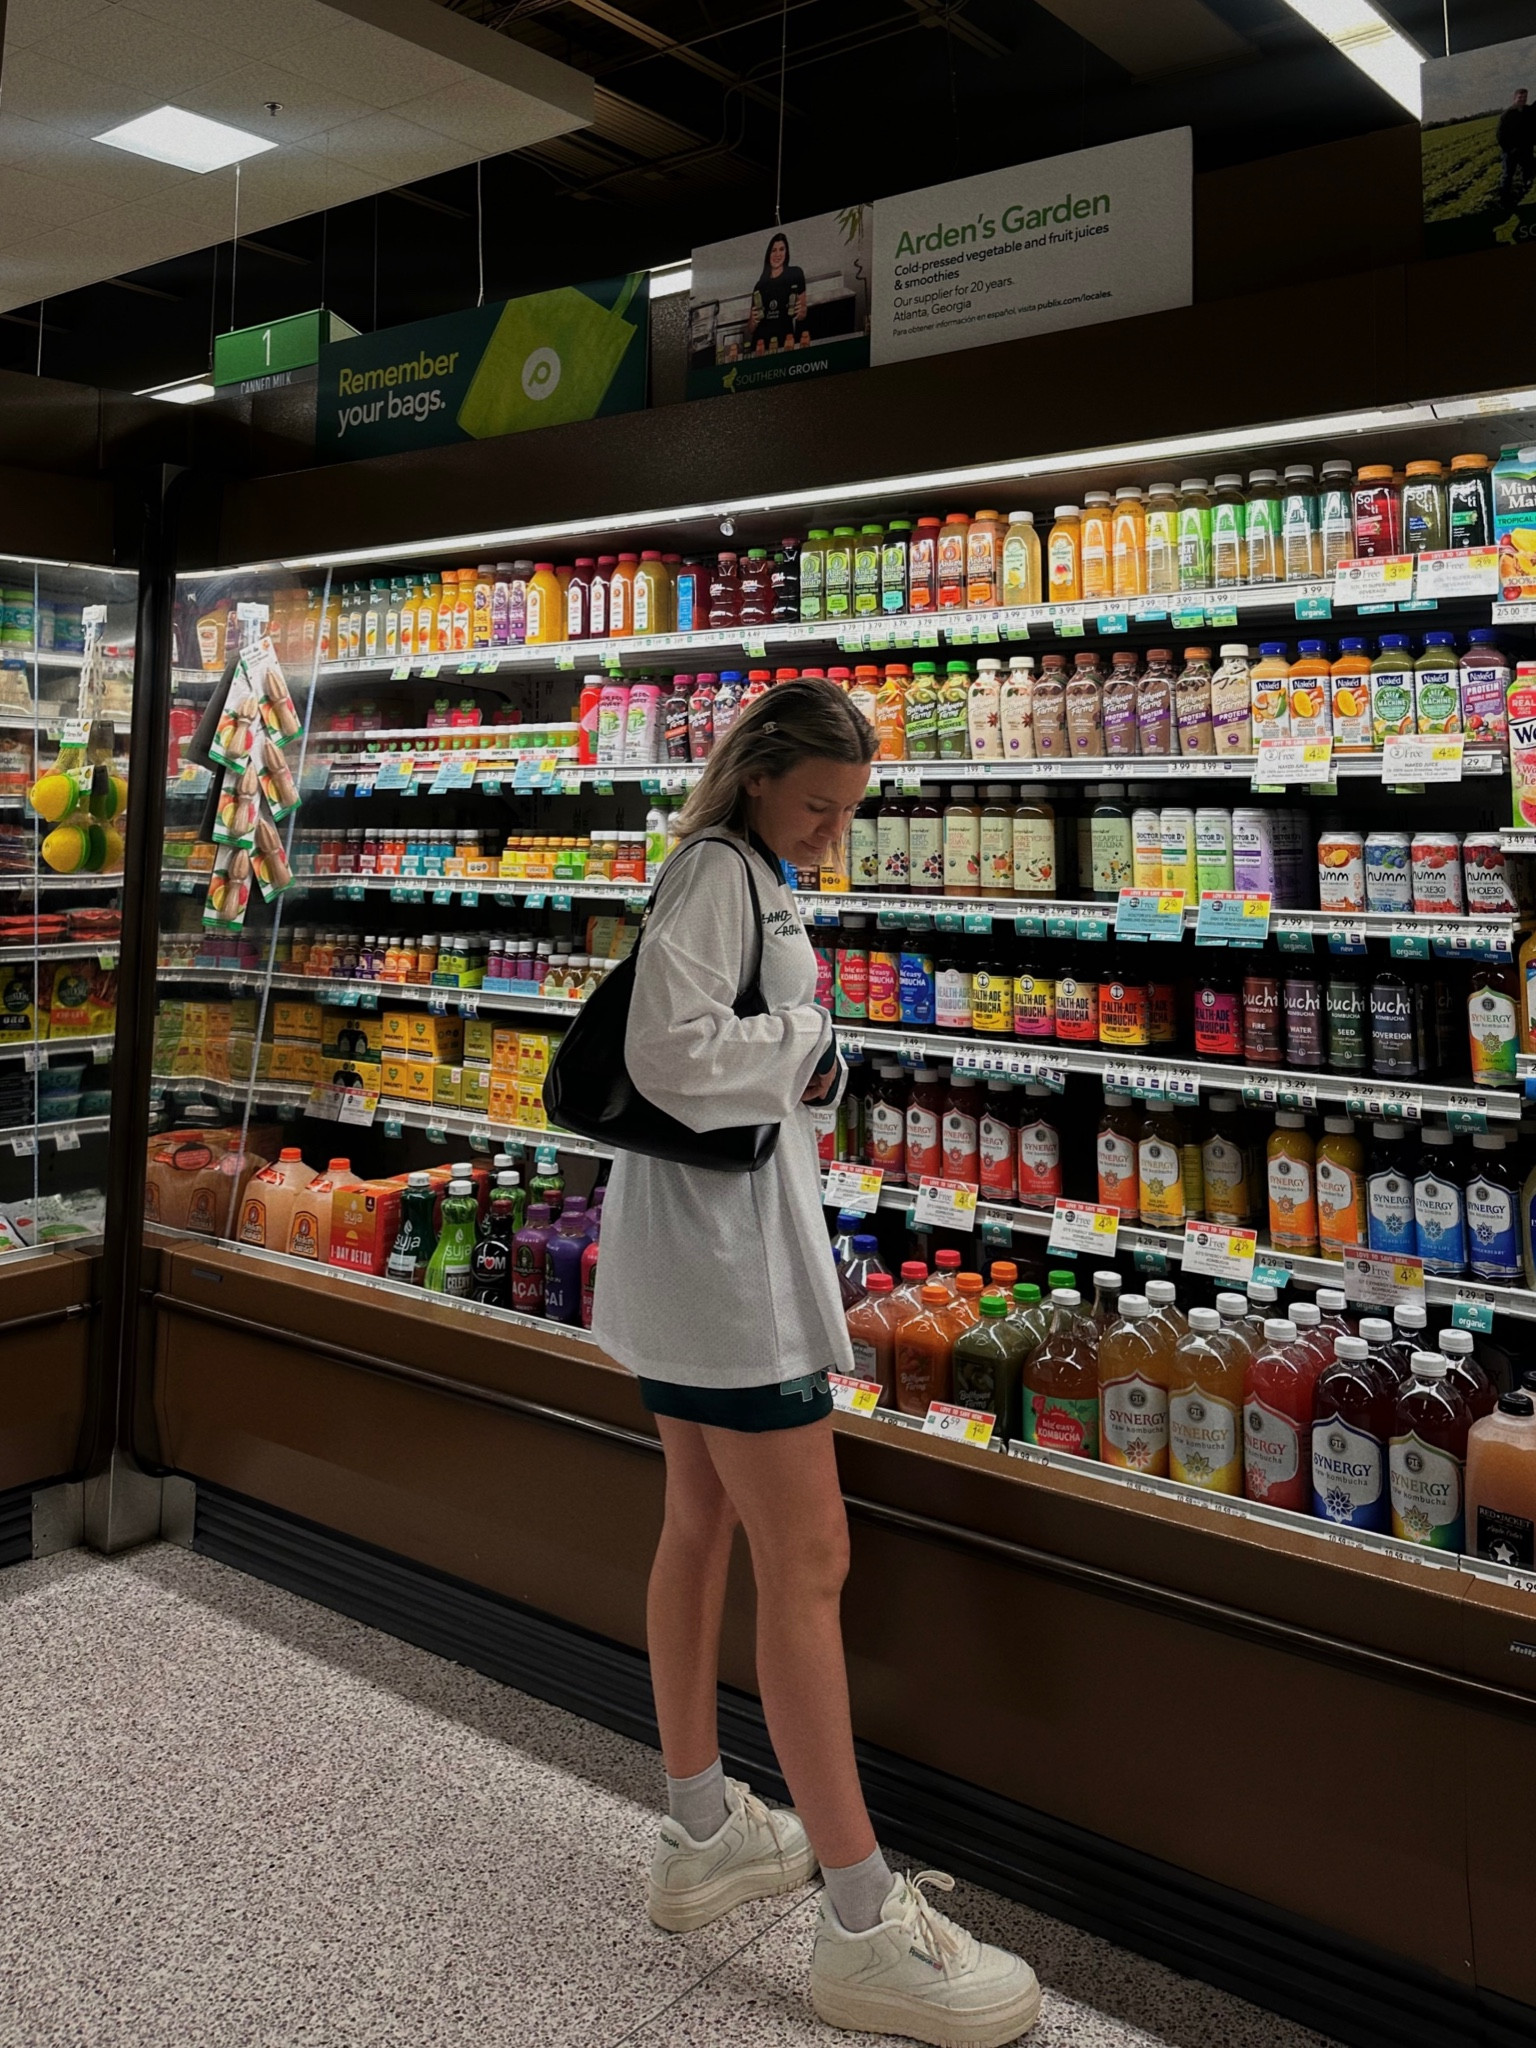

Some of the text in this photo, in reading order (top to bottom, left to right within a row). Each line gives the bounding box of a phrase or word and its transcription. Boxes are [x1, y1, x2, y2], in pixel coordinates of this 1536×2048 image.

[895, 194, 1110, 258] Arden's Garden
[895, 223, 1109, 276] Cold-pressed vegetable and fruit juices
[895, 268, 960, 291] & smoothies
[894, 276, 1014, 309] Our supplier for 20 years.
[893, 299, 972, 322] Atlanta, Georgia
[893, 328, 907, 337] Para
[908, 322, 934, 334] obtener
[1018, 304, 1036, 314] visita
[263, 329, 271, 366] 1
[339, 349, 459, 398] Remember
[736, 359, 828, 386] SOUTHERN GROWN
[273, 372, 292, 388] MILK
[338, 388, 446, 437] your bags.
[1498, 516, 1532, 525] TROPICAL
[1301, 609, 1326, 617] organic
[1466, 684, 1499, 695] PROTEIN
[1104, 712, 1129, 721] PROTEIN
[1140, 710, 1163, 720] PROTEIN
[1180, 712, 1206, 724] PROTEIN
[1218, 710, 1248, 720] PROTEIN
[1367, 866, 1407, 882] humm
[1466, 866, 1504, 881] humm
[1282, 917, 1302, 926] 2.99
[1333, 919, 1354, 927] 2.99
[1396, 922, 1418, 930] 2.99
[1437, 923, 1460, 932] 2.99
[1476, 925, 1499, 934] 2.99
[1396, 948, 1423, 957] organic
[1243, 987, 1278, 1008] buchi
[1284, 990, 1320, 1010] buchi
[1326, 991, 1365, 1012] buchi
[1370, 993, 1411, 1015] buchi
[1471, 1013, 1512, 1023] SYNERGY
[1252, 1022, 1266, 1030] FIRE
[1290, 1026, 1312, 1034] WATER
[1337, 1029, 1355, 1037] SEED
[1372, 1031, 1412, 1040] SOVEREIGN
[1249, 1076, 1268, 1084] 3.29
[1286, 1080, 1306, 1089] 3.29
[1353, 1086, 1373, 1096] 3.29
[1390, 1090, 1411, 1099] 3.29
[1455, 1123, 1482, 1132] organic
[1024, 1143, 1057, 1152] SYNERGY
[1269, 1175, 1305, 1187] SYNERGY
[1416, 1199, 1453, 1211] SYNERGY
[344, 1211, 363, 1225] suja
[395, 1235, 421, 1251] suja
[330, 1245, 372, 1266] 1-DAY DETOX
[446, 1242, 472, 1260] suja
[1257, 1275, 1282, 1285] organic
[1458, 1318, 1486, 1329] organic
[1109, 1408, 1168, 1425] SYNERGY
[1038, 1427, 1080, 1442] KOMBUCHA
[1111, 1423, 1164, 1434] raw kombucha
[1171, 1421, 1229, 1441] SYNERGY
[1188, 1438, 1225, 1450] kombucha
[1243, 1436, 1288, 1456] NERGY
[1314, 1452, 1372, 1477] SYNERGY
[1327, 1470, 1368, 1486] kombucha
[1391, 1470, 1451, 1497] SYNERGY
[1403, 1492, 1447, 1506] kombucha
[1479, 1507, 1530, 1528] RED JACKET
